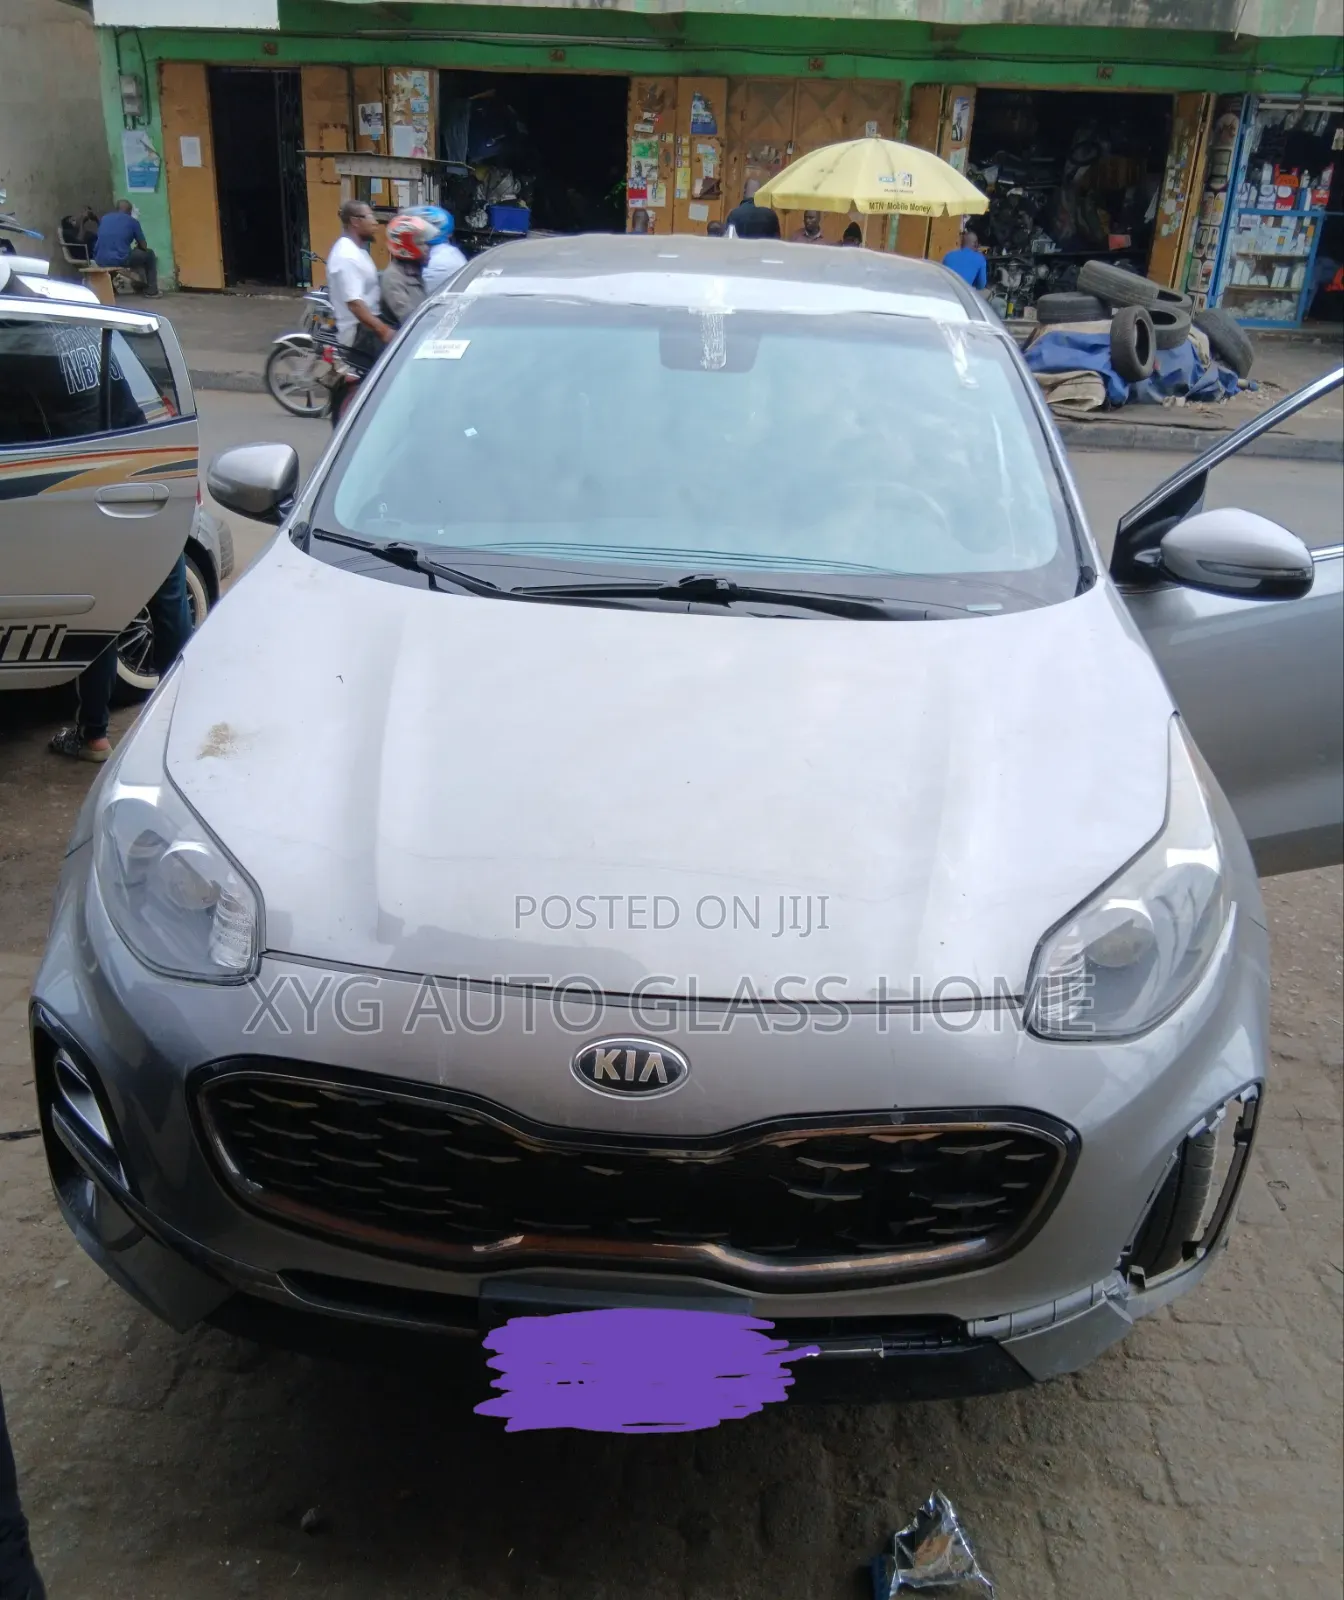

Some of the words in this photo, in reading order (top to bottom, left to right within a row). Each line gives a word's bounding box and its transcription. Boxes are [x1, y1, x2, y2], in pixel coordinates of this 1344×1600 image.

[869, 202, 884, 210] MTN
[887, 202, 909, 211] Mobile
[910, 203, 931, 214] Money
[593, 1048, 668, 1084] KIA
